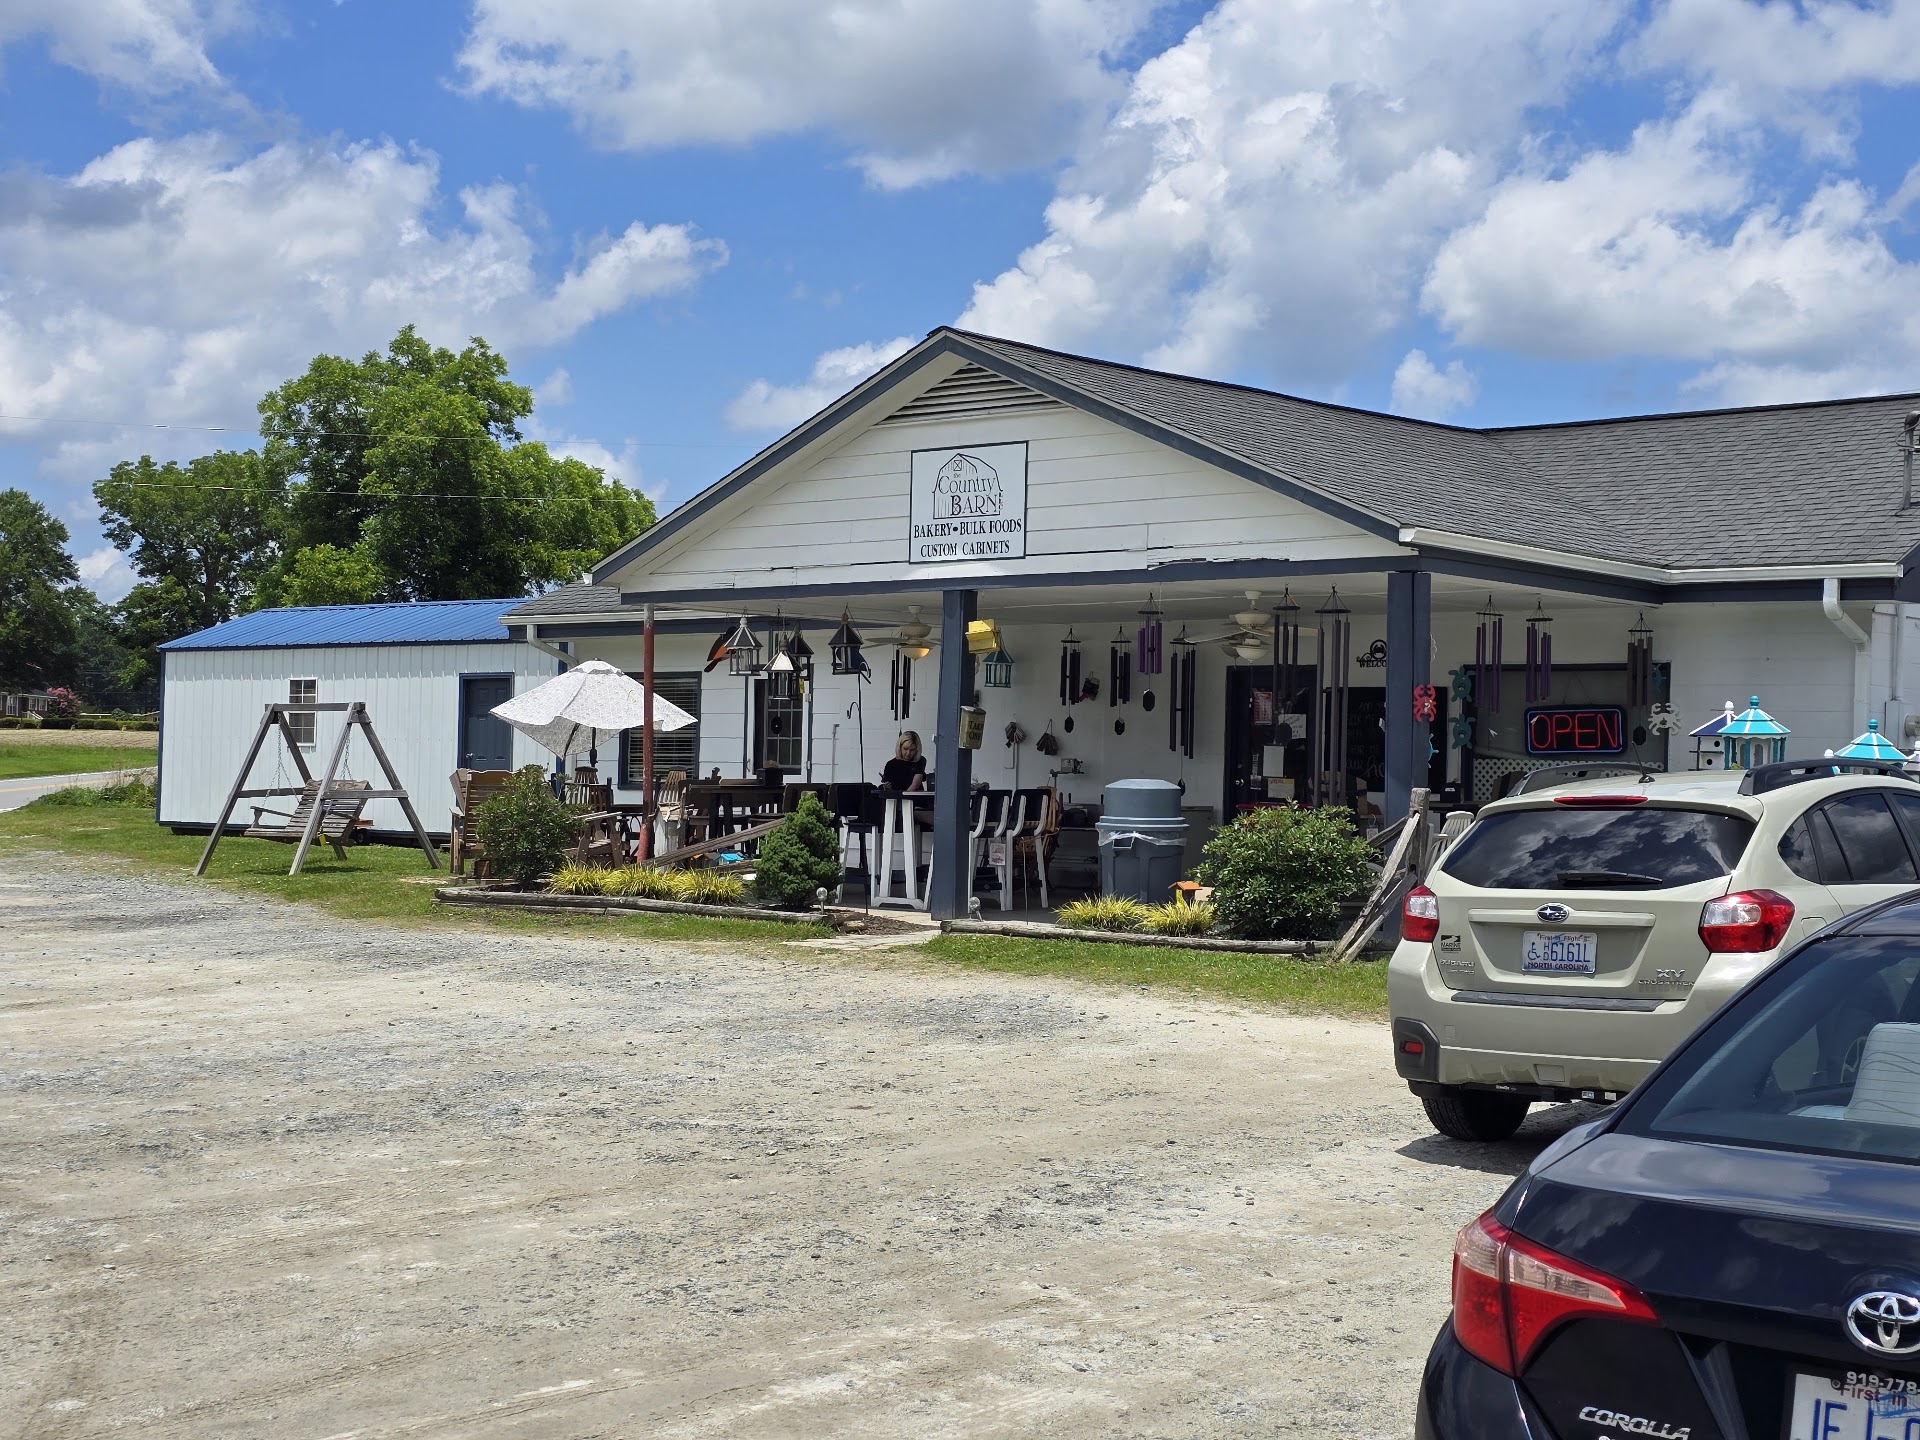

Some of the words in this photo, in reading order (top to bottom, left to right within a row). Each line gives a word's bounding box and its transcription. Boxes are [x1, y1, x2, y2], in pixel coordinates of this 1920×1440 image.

[938, 475, 996, 496] Country
[950, 494, 998, 516] BARN
[914, 523, 952, 538] BAKERY
[960, 520, 987, 535] BULK
[989, 518, 1022, 534] FOODS
[920, 543, 958, 557] CUSTOM
[962, 540, 1010, 555] CABINETS
[969, 720, 984, 730] TAKE
[1531, 713, 1618, 749] OPEN
[968, 731, 982, 741] ONE
[1550, 942, 1591, 963] 6161L
[1527, 961, 1553, 969] NORTH
[1554, 963, 1589, 971] CAROLINA
[1656, 968, 1686, 978] XV
[1840, 1384, 1881, 1402] First
[1891, 1390, 1908, 1407] in
[1579, 1406, 1692, 1440] COROLLA
